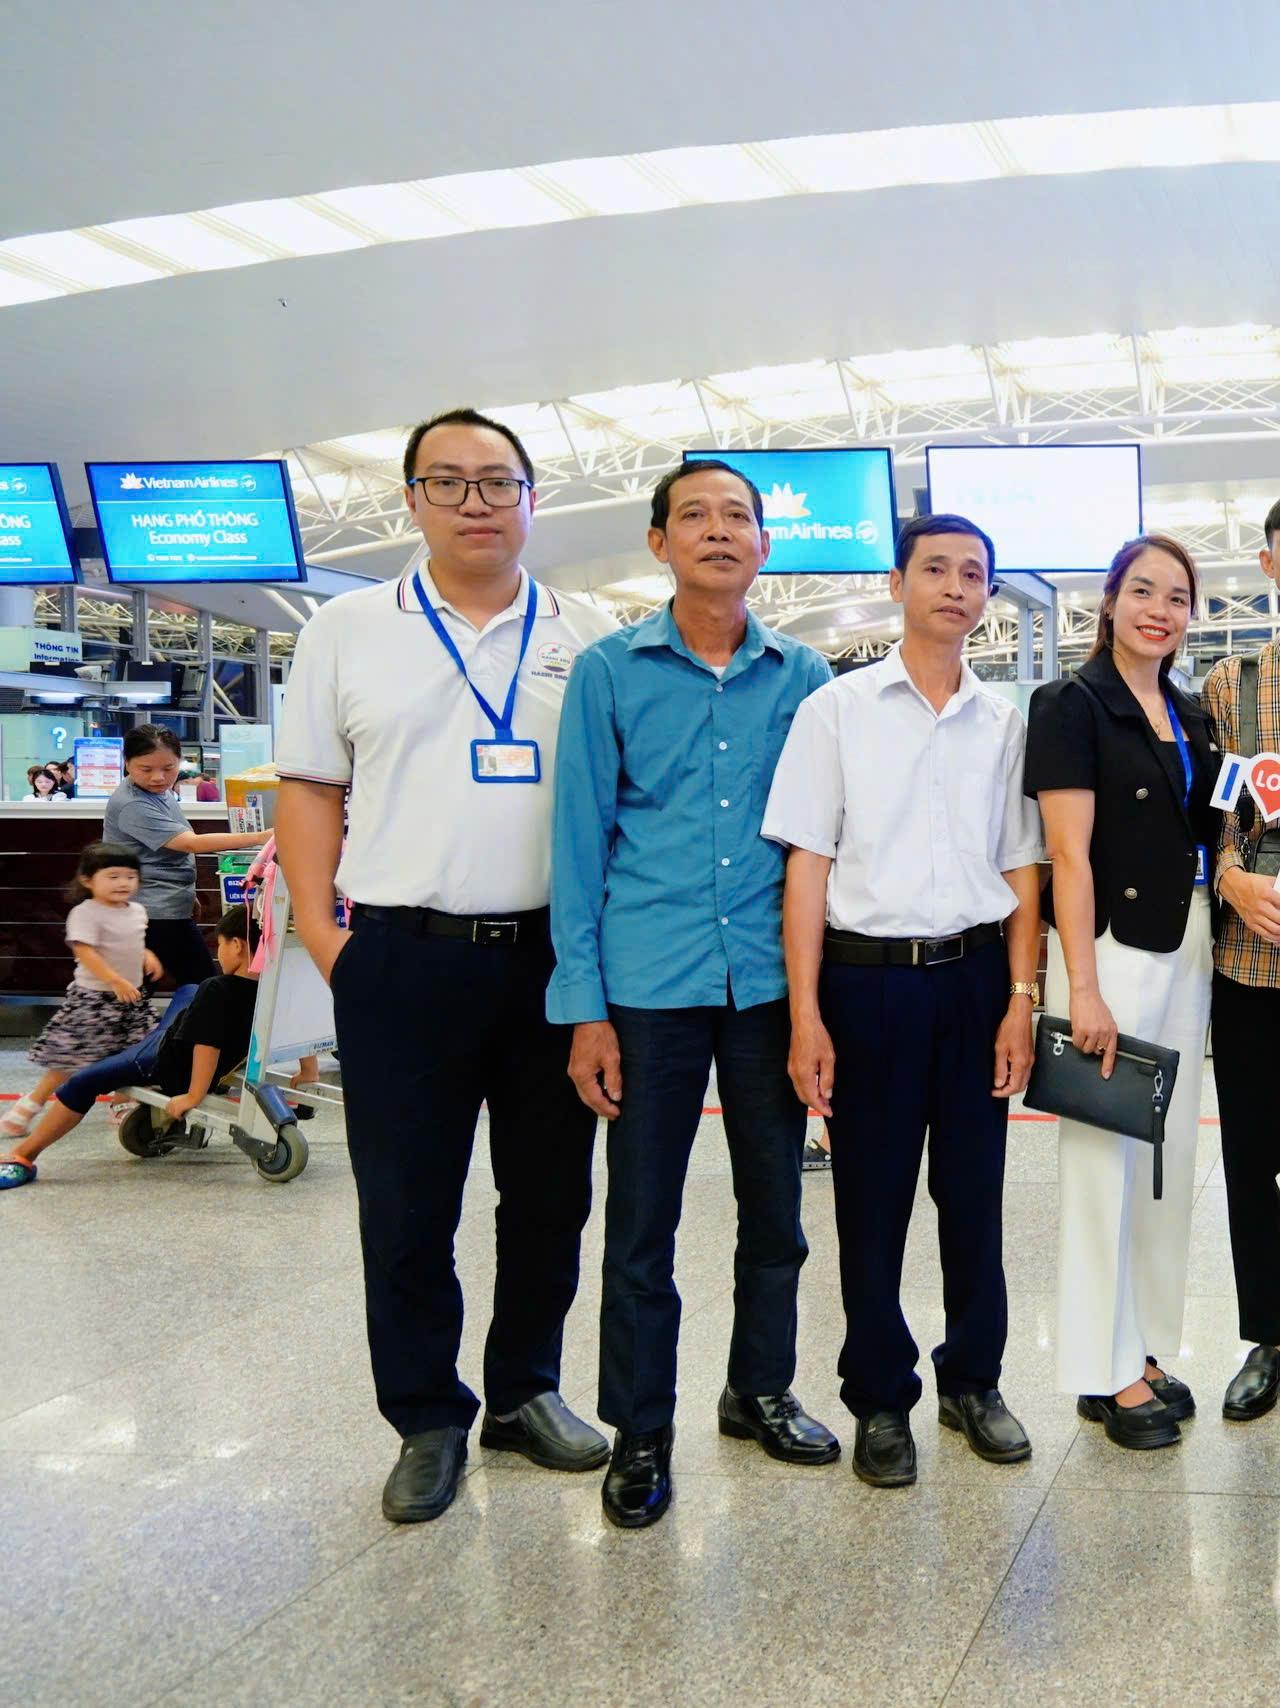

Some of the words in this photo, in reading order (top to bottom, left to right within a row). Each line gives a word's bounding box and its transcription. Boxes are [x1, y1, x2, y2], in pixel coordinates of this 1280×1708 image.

[149, 531, 210, 547] Economy
[213, 530, 248, 545] Class
[1221, 763, 1240, 801] I
